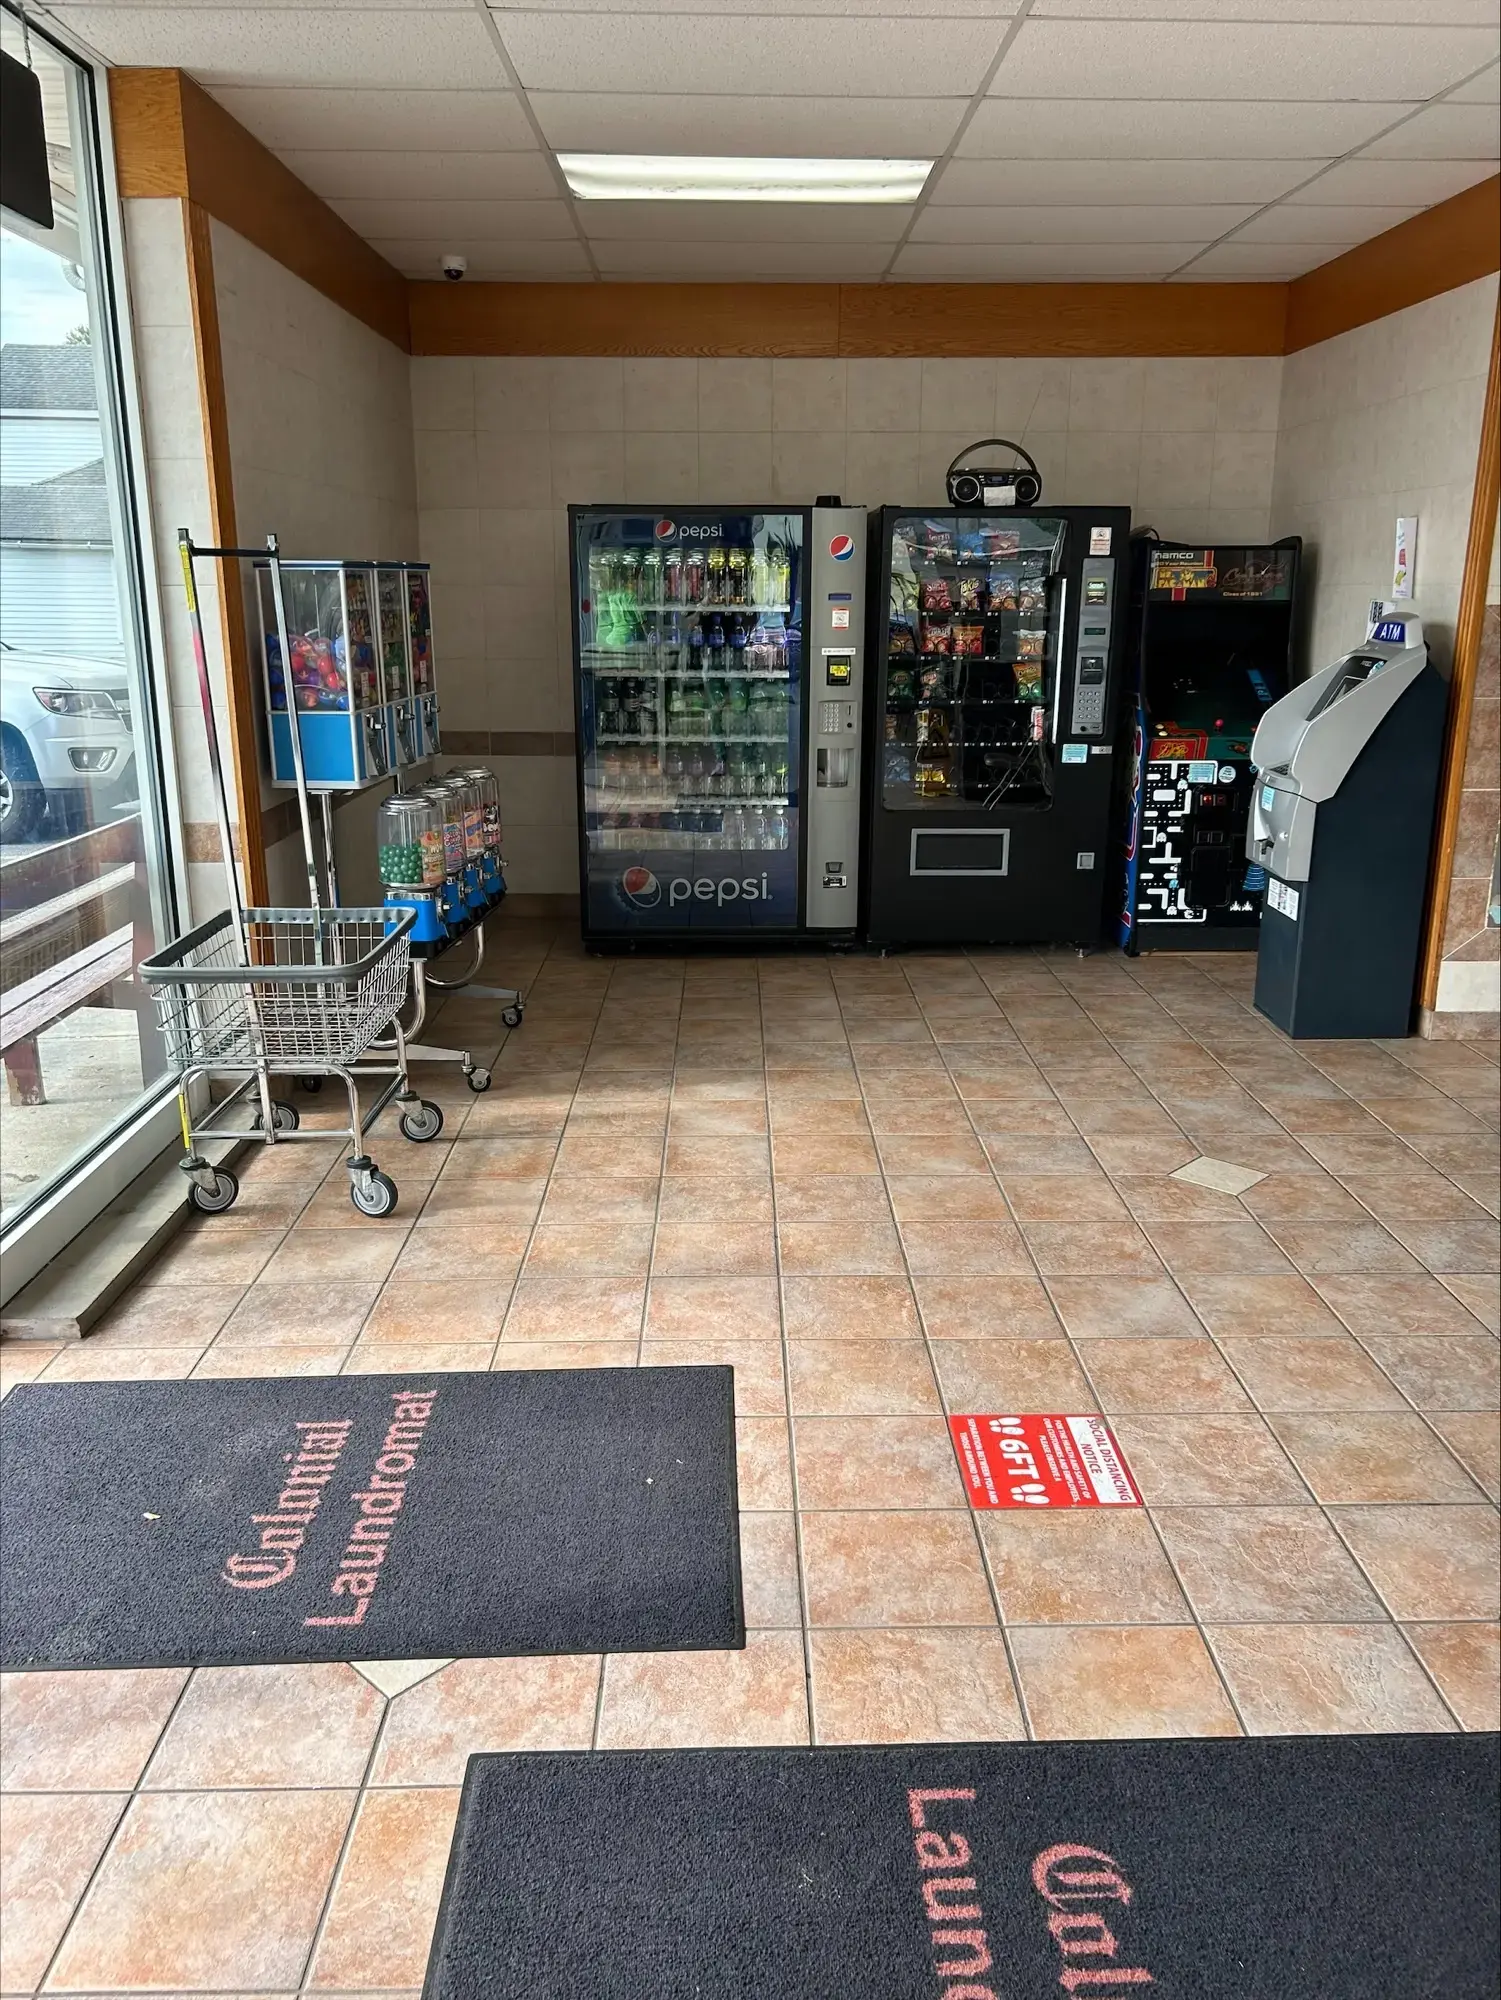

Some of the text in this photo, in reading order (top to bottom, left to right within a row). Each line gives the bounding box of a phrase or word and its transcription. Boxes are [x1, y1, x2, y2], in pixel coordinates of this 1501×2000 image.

[679, 523, 723, 540] pepsi
[1155, 552, 1194, 560] namco
[1379, 623, 1402, 641] ATM
[669, 871, 769, 908] pepsi
[960, 1432, 973, 1450] THOSE
[1039, 1435, 1052, 1453] PLEASE
[1057, 1430, 1068, 1439] THE
[964, 1450, 978, 1474] AROUND
[967, 1418, 999, 1504] SEPARATION BETWEEN YOU AND
[1000, 1439, 1039, 1479] 6FT
[1057, 1458, 1068, 1469] AND
[1068, 1459, 1079, 1470] AND
[1080, 1444, 1102, 1474] NOTICE
[1087, 1419, 1131, 1501] SOCIAL DISTANCING
[1071, 1471, 1087, 1490] SAFETY
[222, 1419, 354, 1590] Colonial
[302, 1390, 438, 1627] Laundromat
[907, 1787, 999, 2000] Laun
[1031, 1842, 1154, 2000] Col
